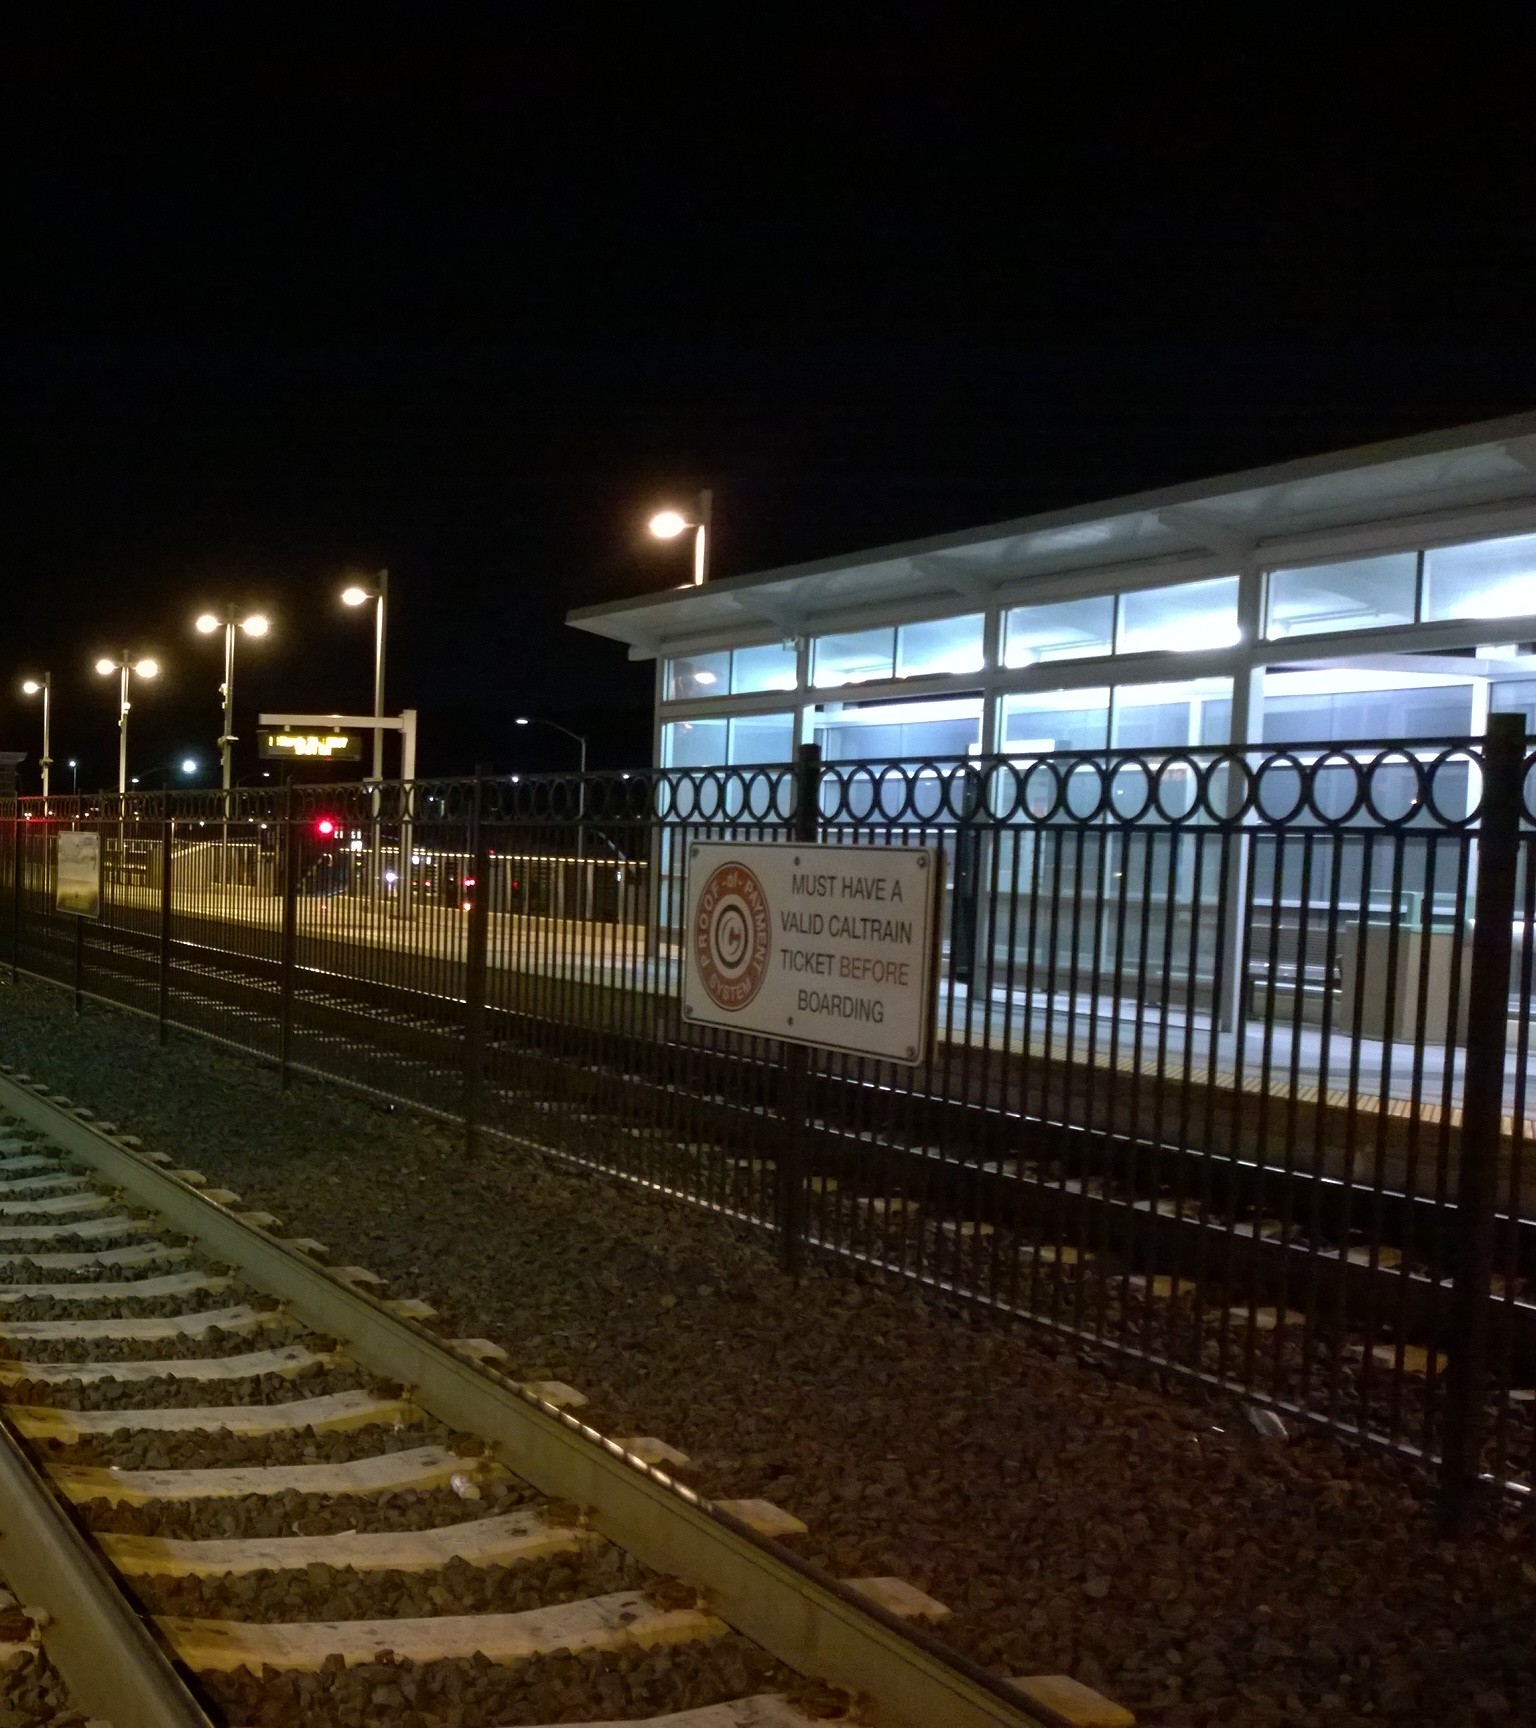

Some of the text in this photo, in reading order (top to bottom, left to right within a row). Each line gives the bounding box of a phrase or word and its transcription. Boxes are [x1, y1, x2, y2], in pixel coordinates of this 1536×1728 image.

[792, 873, 903, 902] MUST HAVE A
[698, 881, 719, 968] PROOF
[744, 880, 768, 977] PAYMENT
[781, 911, 912, 944] VALID CALTRAIN
[780, 949, 909, 986] TICKET BEFORE
[709, 973, 752, 1002] SYSTEM
[798, 989, 884, 1023] BOARDING
